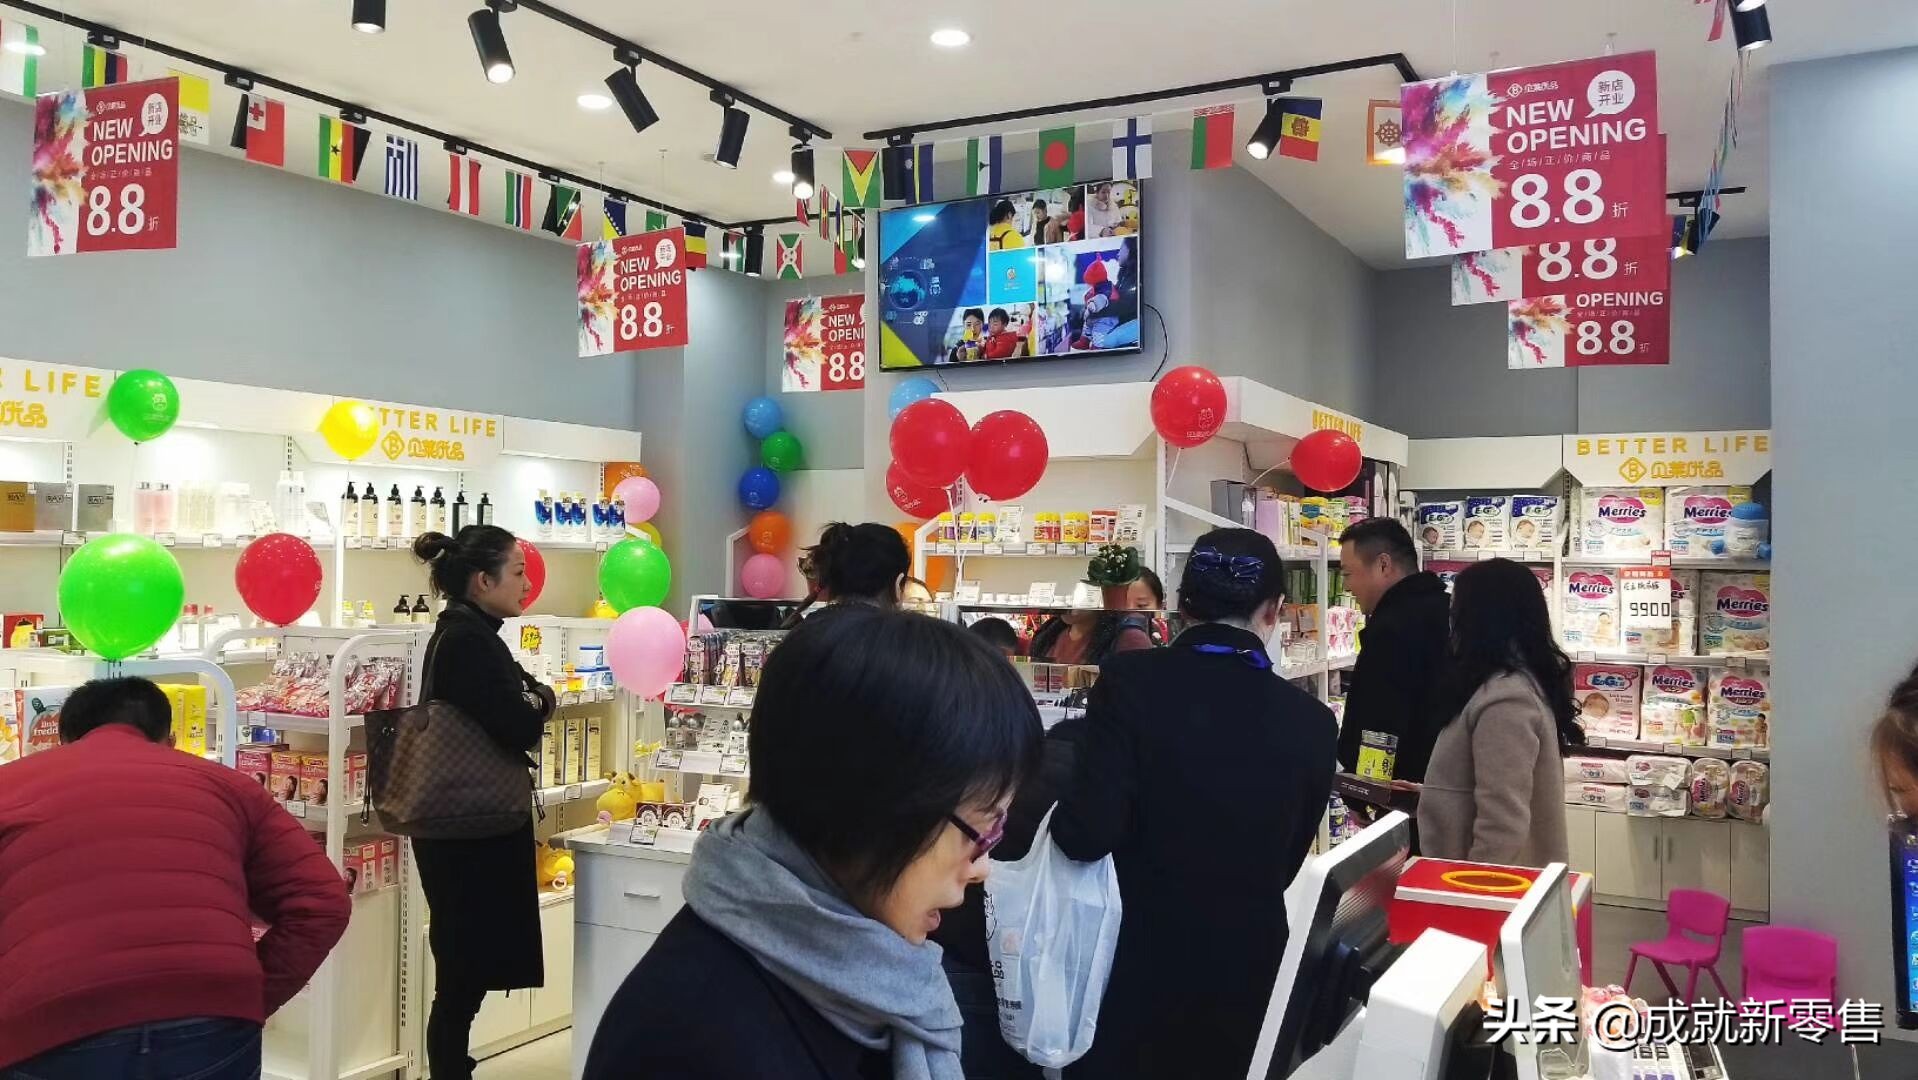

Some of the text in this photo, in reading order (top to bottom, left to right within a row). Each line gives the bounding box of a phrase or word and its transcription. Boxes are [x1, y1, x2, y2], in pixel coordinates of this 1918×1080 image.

[1598, 79, 1624, 93] 新店
[1598, 93, 1624, 106] 开业
[1507, 98, 1574, 128] NEW
[93, 117, 133, 142] NEW
[1507, 118, 1646, 154] OPENING
[91, 139, 173, 166] OPENING
[86, 183, 145, 236] 8.8
[1509, 168, 1629, 228] 8.8 折
[620, 256, 650, 275] NEW
[1537, 238, 1618, 282] 8.8
[620, 269, 681, 292] OPENING
[1576, 291, 1664, 308] OPENING
[620, 301, 663, 340] 8.8
[829, 314, 855, 327] NEW
[828, 327, 864, 342] OPENI
[1576, 320, 1636, 355] 8.8
[829, 351, 864, 382] 8.8
[25, 368, 102, 398] LIFE
[369, 406, 497, 437] TTER LIFE
[1312, 409, 1344, 432] BETTER
[1576, 435, 1769, 456] BETTER LIFE
[1598, 506, 1648, 519] Merries
[1568, 581, 1615, 595] Merries
[1630, 602, 1670, 617] 9900
[1716, 599, 1770, 612] Merries
[1652, 675, 1696, 689] Merries
[1720, 686, 1766, 699] Merries
